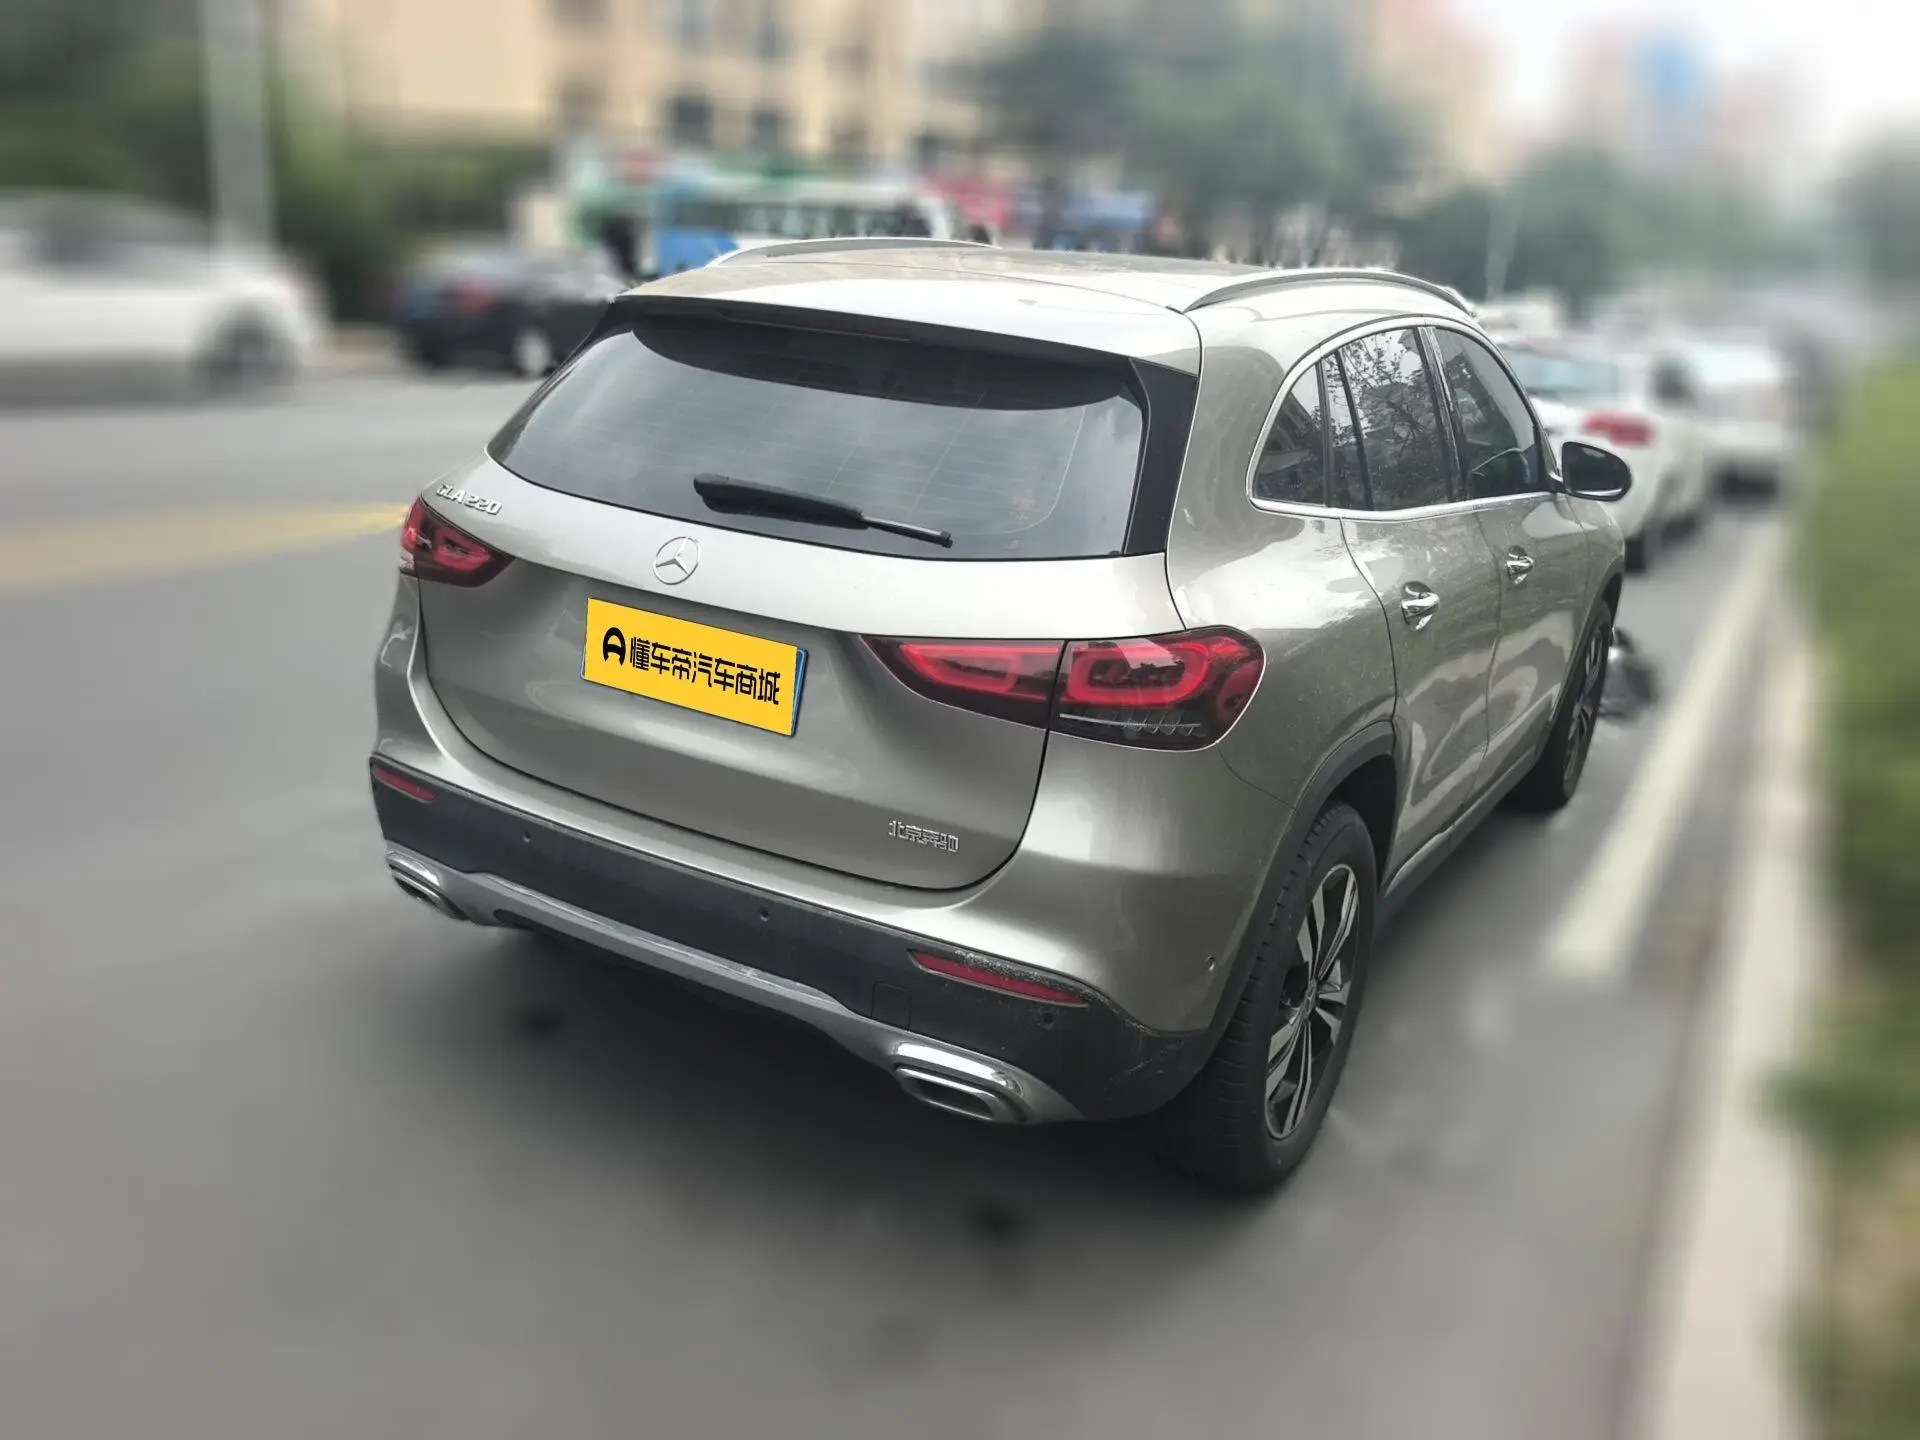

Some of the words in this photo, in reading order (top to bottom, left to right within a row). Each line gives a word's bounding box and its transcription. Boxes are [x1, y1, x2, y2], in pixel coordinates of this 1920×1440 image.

[436, 484, 466, 504] GLA
[464, 495, 502, 515] 220
[888, 820, 959, 853] 北京奔驰
